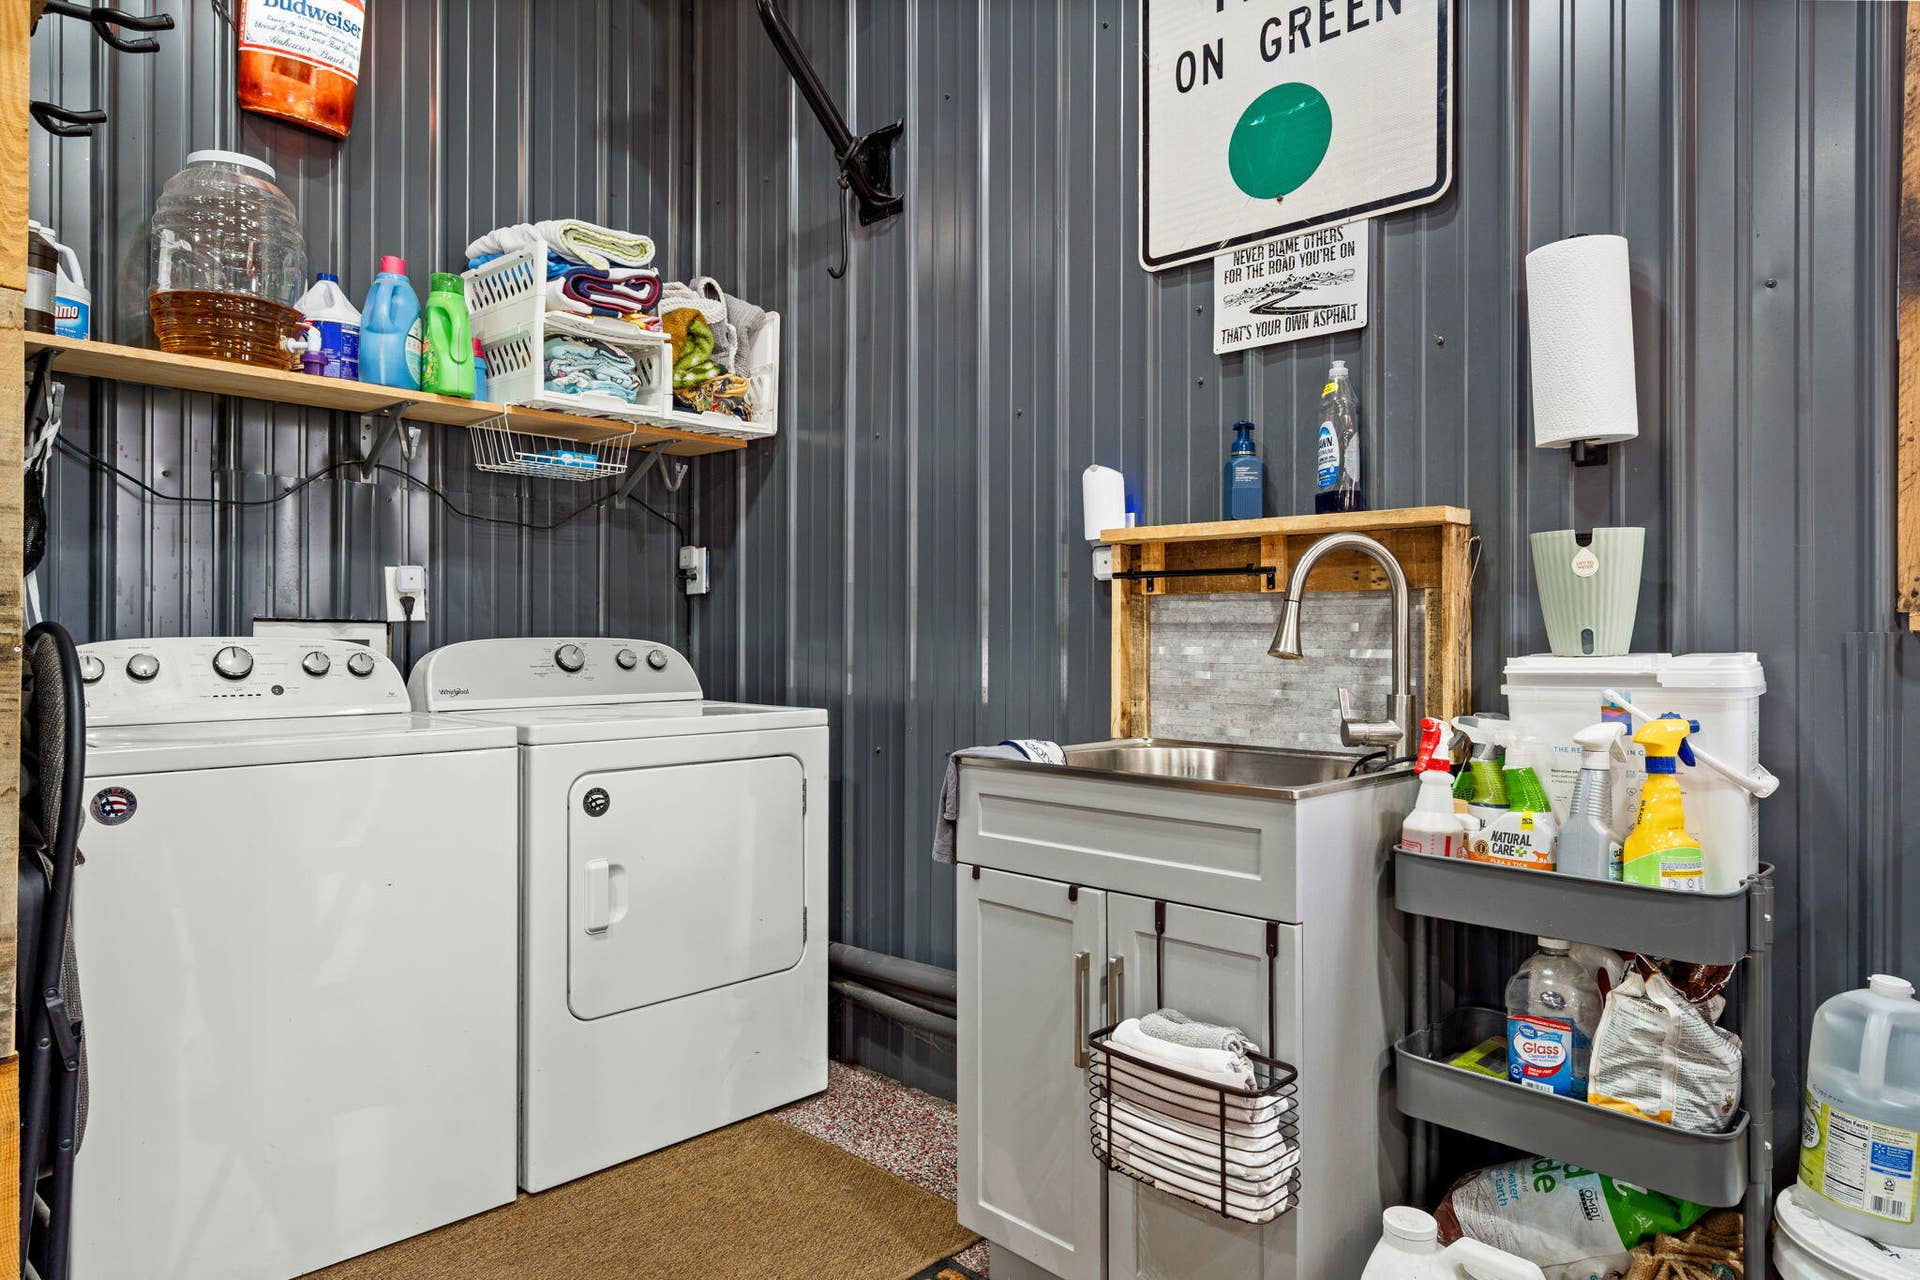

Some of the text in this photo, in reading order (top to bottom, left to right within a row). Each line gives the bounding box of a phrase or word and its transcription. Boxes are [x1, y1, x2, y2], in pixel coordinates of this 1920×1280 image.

[1175, 37, 1224, 94] ON
[1233, 226, 1344, 267] NEVER BLAME OTHERS
[1224, 241, 1356, 285] FOR THE ROAD YOU'RE ON
[1221, 303, 1358, 345] THAT'S YOUR OWN ASPHALT
[438, 687, 470, 698] Whirlpool
[1637, 800, 1646, 825] BLEACH
[1490, 830, 1532, 847] NATURAL
[1491, 842, 1516, 857] CARE
[1489, 857, 1506, 866] FLEA
[1512, 860, 1529, 869] TICK
[1523, 1042, 1559, 1055] Glass
[1830, 1111, 1869, 1130] Nutrition Facts
[1584, 1188, 1602, 1221] OMRI
